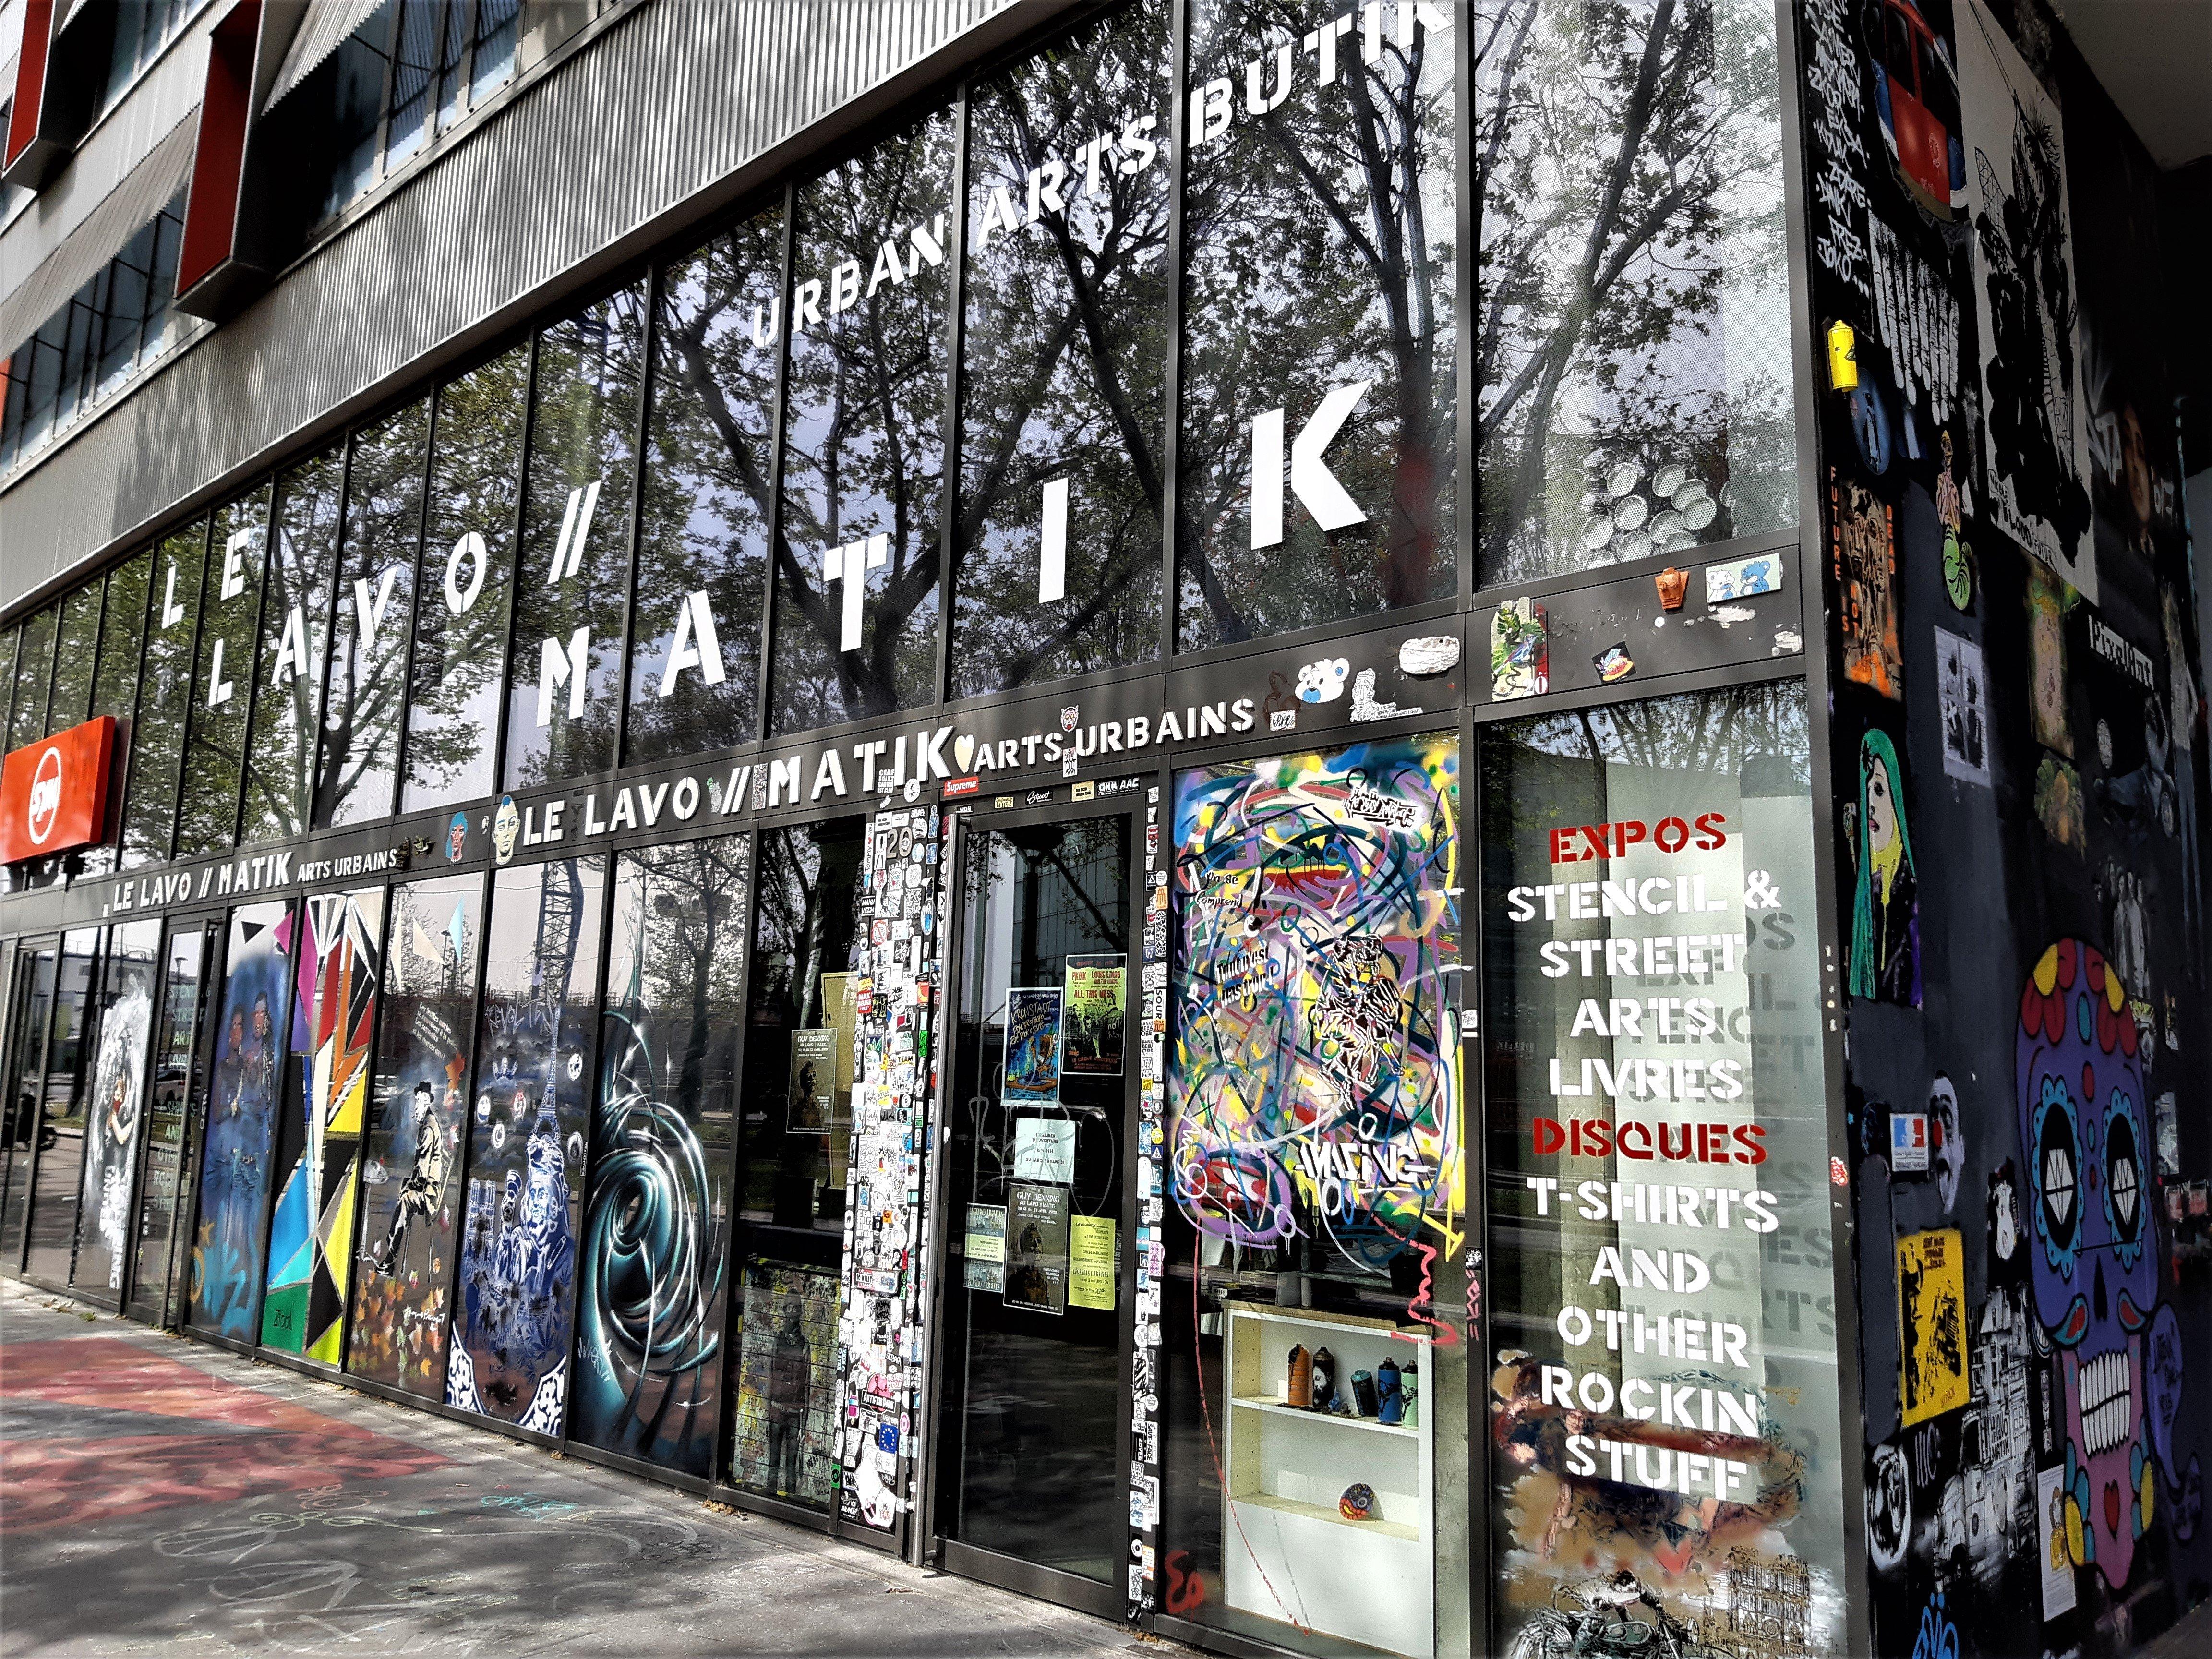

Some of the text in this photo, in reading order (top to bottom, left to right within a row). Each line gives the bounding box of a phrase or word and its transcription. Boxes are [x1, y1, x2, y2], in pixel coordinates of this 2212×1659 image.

[753, 211, 945, 349] URBAN
[977, 114, 1155, 247] ARTS
[1831, 466, 1841, 581] FUTURE
[162, 527, 249, 629] LE
[536, 379, 1372, 727] MATIK
[208, 531, 487, 706] LAVO
[523, 800, 564, 846] LE
[584, 777, 699, 836] LAVO
[769, 726, 954, 807] MATIK
[973, 731, 1063, 774] ARTS
[1075, 698, 1255, 758] URBAINS
[947, 780, 976, 793] Supreme
[1549, 813, 1727, 864] EXPOS
[113, 880, 134, 912] LE
[140, 872, 191, 907] LAVO
[217, 852, 292, 895] MATIK
[296, 863, 330, 883] ARTS
[334, 850, 397, 878] URBAINS
[1508, 870, 1782, 922] STENCIL &
[1540, 933, 1745, 978] STREET
[1074, 989, 1114, 998] ALL THIS MESS
[1570, 998, 1717, 1037] ARTS
[1549, 1058, 1743, 1099] LIVRES
[1533, 1118, 1767, 1165] DISQUES
[1017, 1191, 1060, 1203] GUY DENNING
[1527, 1178, 1779, 1234] T-SHIRTS
[1589, 1246, 1711, 1294] AND
[1557, 1306, 1750, 1369] OTHER
[1541, 1365, 1758, 1438] ROCKIN
[1564, 1435, 1747, 1501] STUFF
